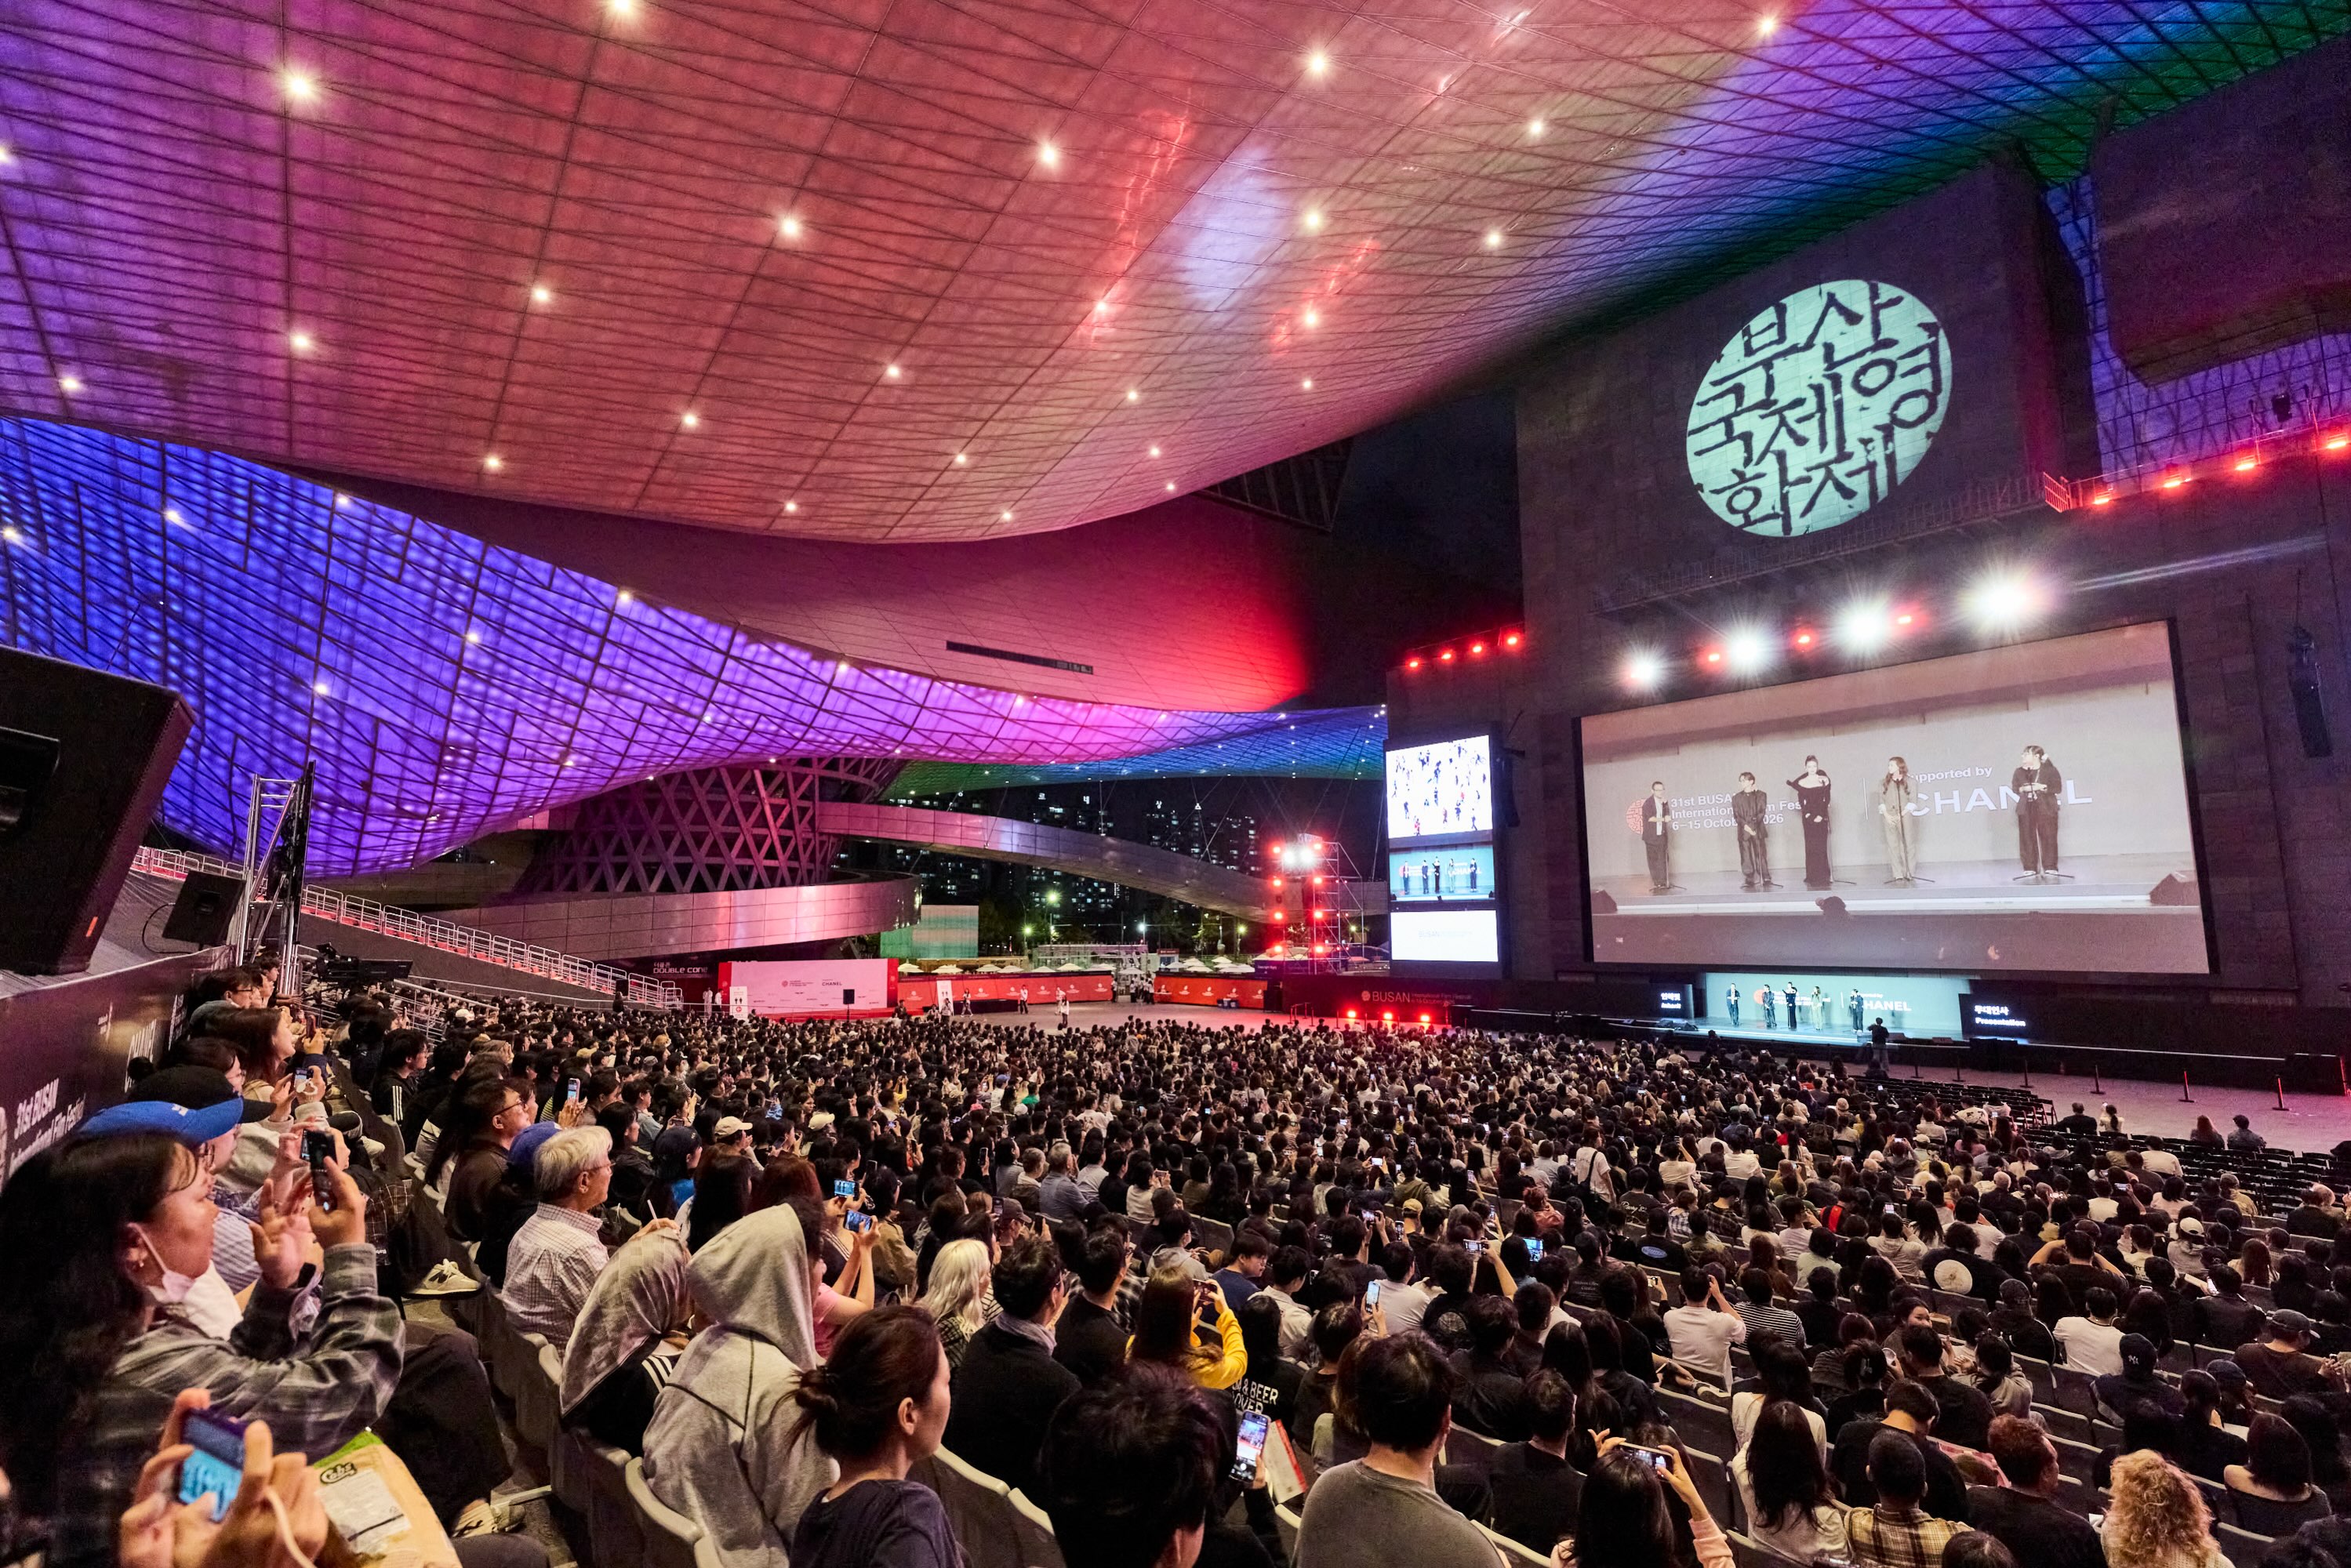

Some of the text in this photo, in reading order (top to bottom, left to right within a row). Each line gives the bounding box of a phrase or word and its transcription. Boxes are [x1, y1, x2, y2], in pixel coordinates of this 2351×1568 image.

[1915, 766, 1993, 784] pported by
[1670, 793, 1736, 808] 31st BUSA
[1910, 779, 2093, 817] CHANL
[1671, 805, 1734, 819] Internation
[1703, 818, 1738, 829] Octob
[1372, 991, 1411, 1003] BUSAN
[1863, 1000, 1913, 1011] HANEL
[1975, 1005, 2009, 1015] 무대인사
[1975, 1017, 2026, 1026] Presentation
[31, 1077, 60, 1126] BUSAN
[1242, 1378, 1248, 1396] &
[1250, 1381, 1278, 1405] BEER
